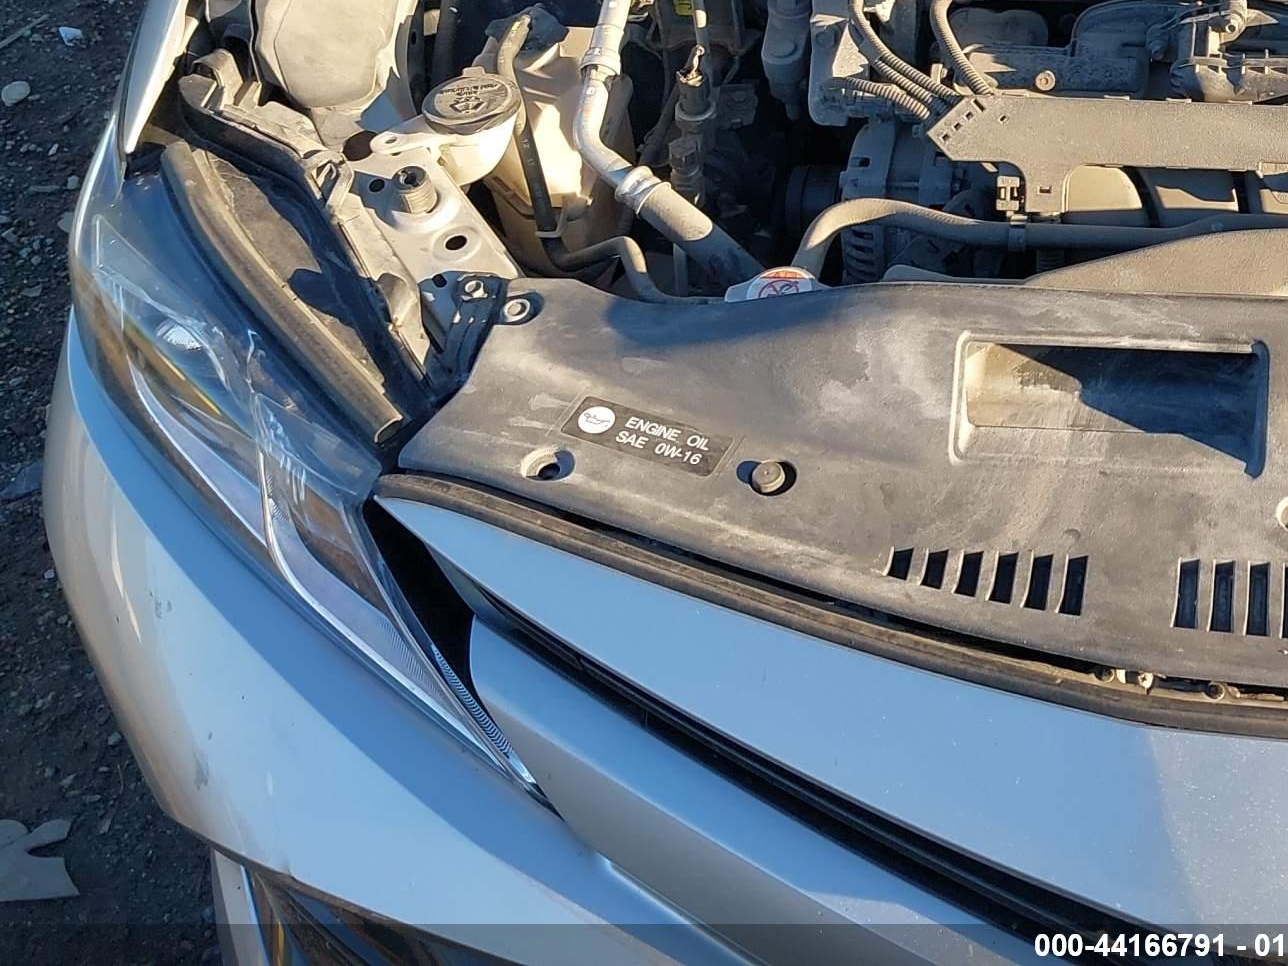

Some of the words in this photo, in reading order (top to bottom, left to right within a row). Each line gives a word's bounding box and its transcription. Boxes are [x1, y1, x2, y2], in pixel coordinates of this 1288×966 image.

[615, 430, 648, 449] SAE
[654, 441, 703, 465] 0W-16
[624, 416, 681, 442] ENGINE
[686, 434, 710, 451] OIL
